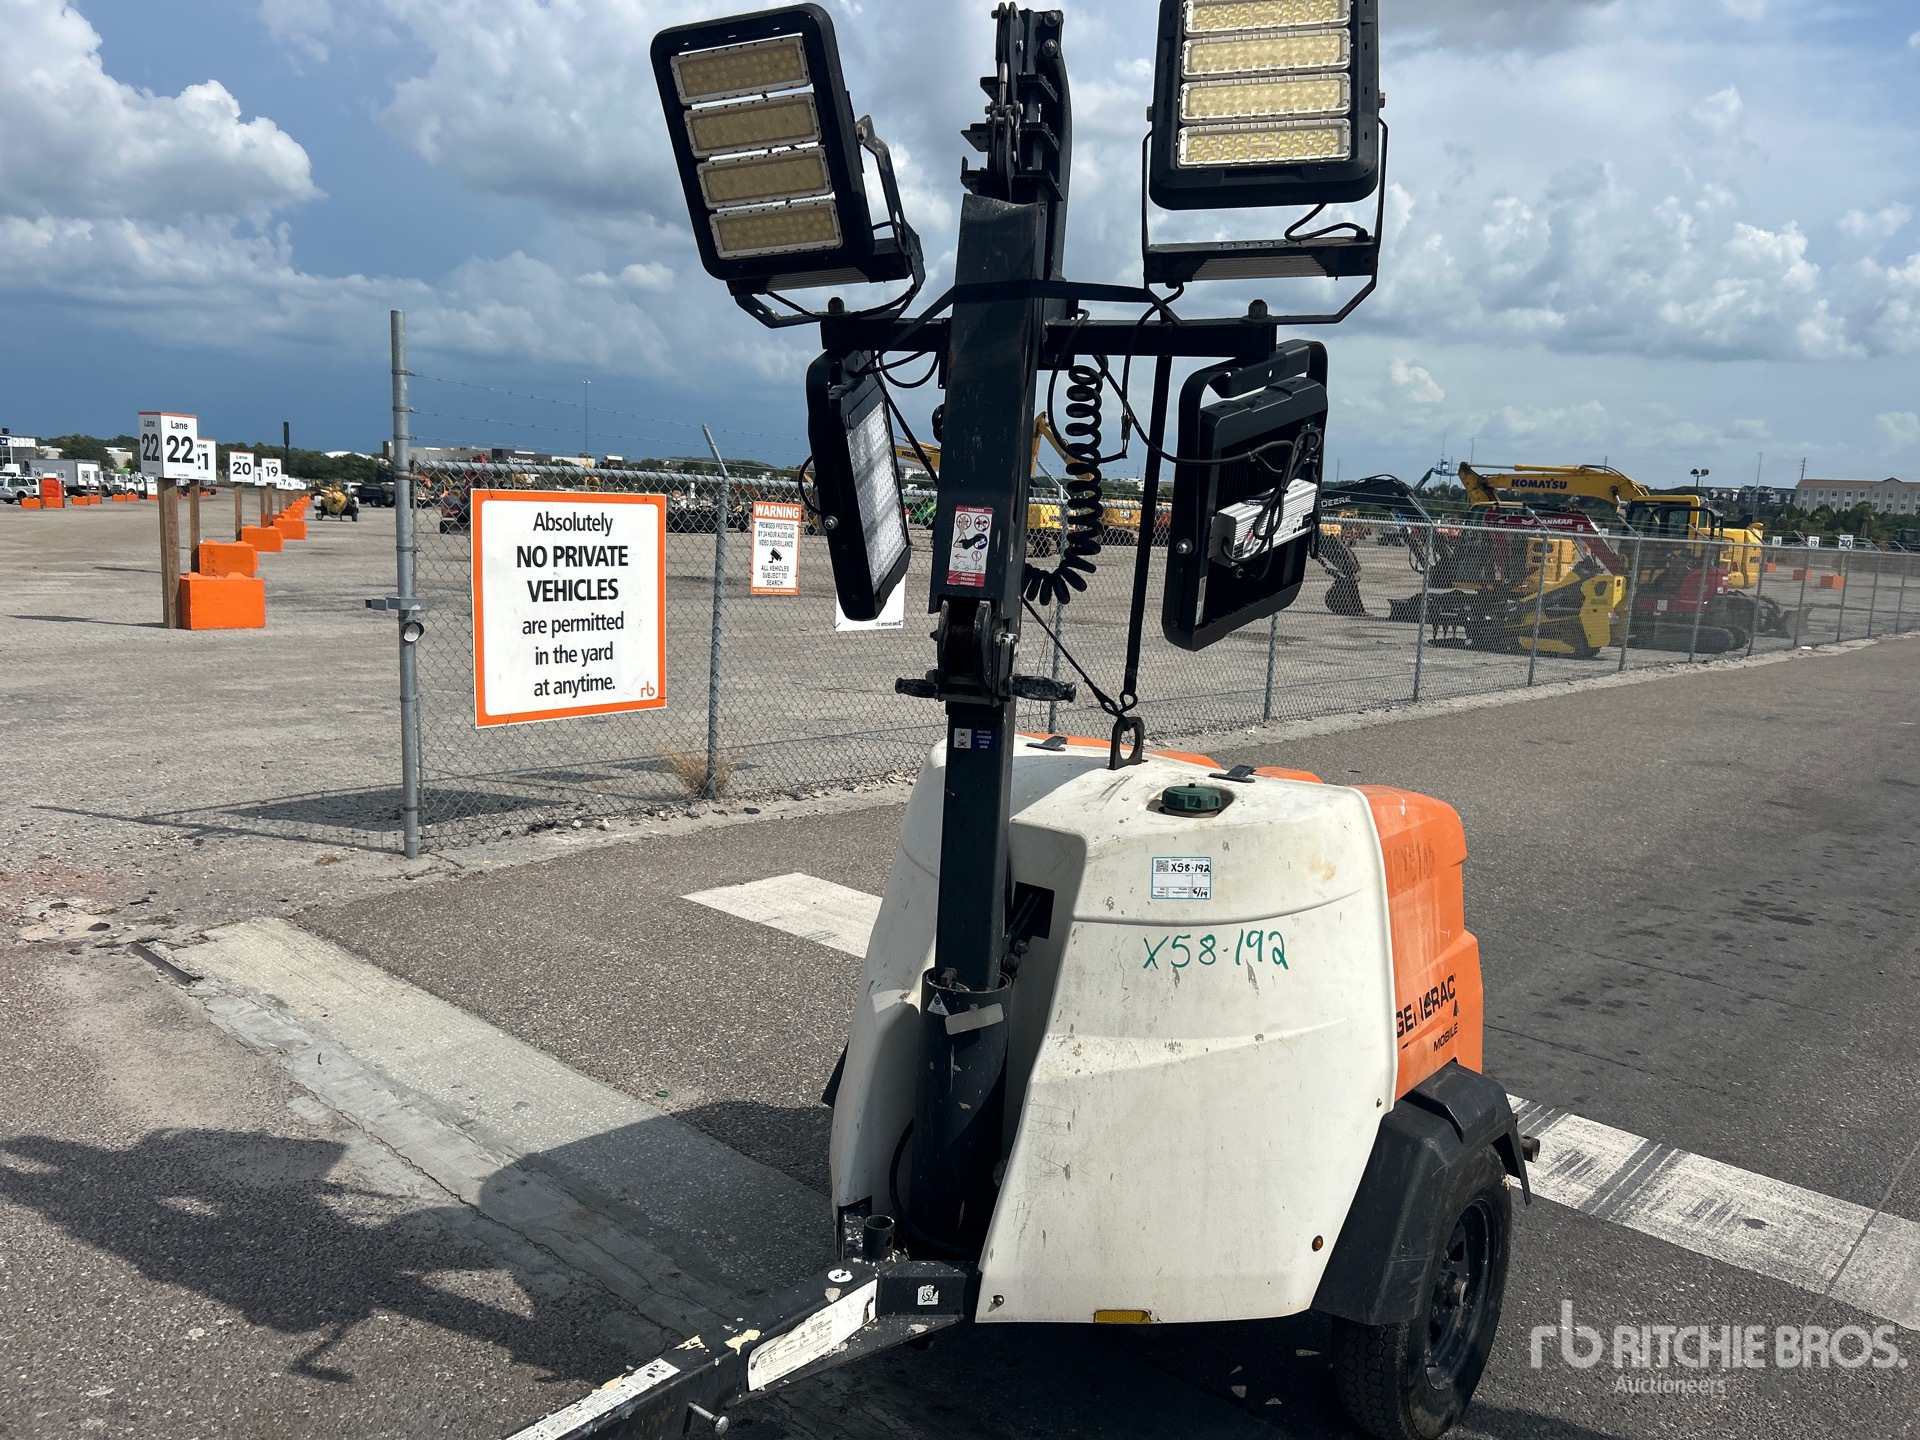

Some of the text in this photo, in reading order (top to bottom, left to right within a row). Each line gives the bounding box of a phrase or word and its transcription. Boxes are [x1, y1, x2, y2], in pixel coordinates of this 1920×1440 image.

[144, 419, 155, 427] Lane
[171, 420, 188, 430] Lane
[142, 433, 160, 461] 22
[166, 435, 195, 463] 22
[232, 462, 251, 475] 20
[265, 466, 279, 477] 19
[1511, 478, 1567, 489] KOMATSU
[755, 503, 799, 519] WARNING
[1321, 496, 1351, 508] DEERE
[533, 511, 613, 537] Absolutely
[1810, 540, 1818, 548] 19
[516, 546, 628, 568] NO PRIVATE
[527, 578, 619, 602] VEHICLES
[522, 611, 625, 638] are permitted
[535, 641, 614, 667] in the yard
[534, 674, 616, 698] at anytime.
[640, 681, 655, 697] rb
[1143, 928, 1289, 970] X58-192
[1396, 975, 1456, 1038] GENERAC
[1433, 1022, 1458, 1052] MOBILE
